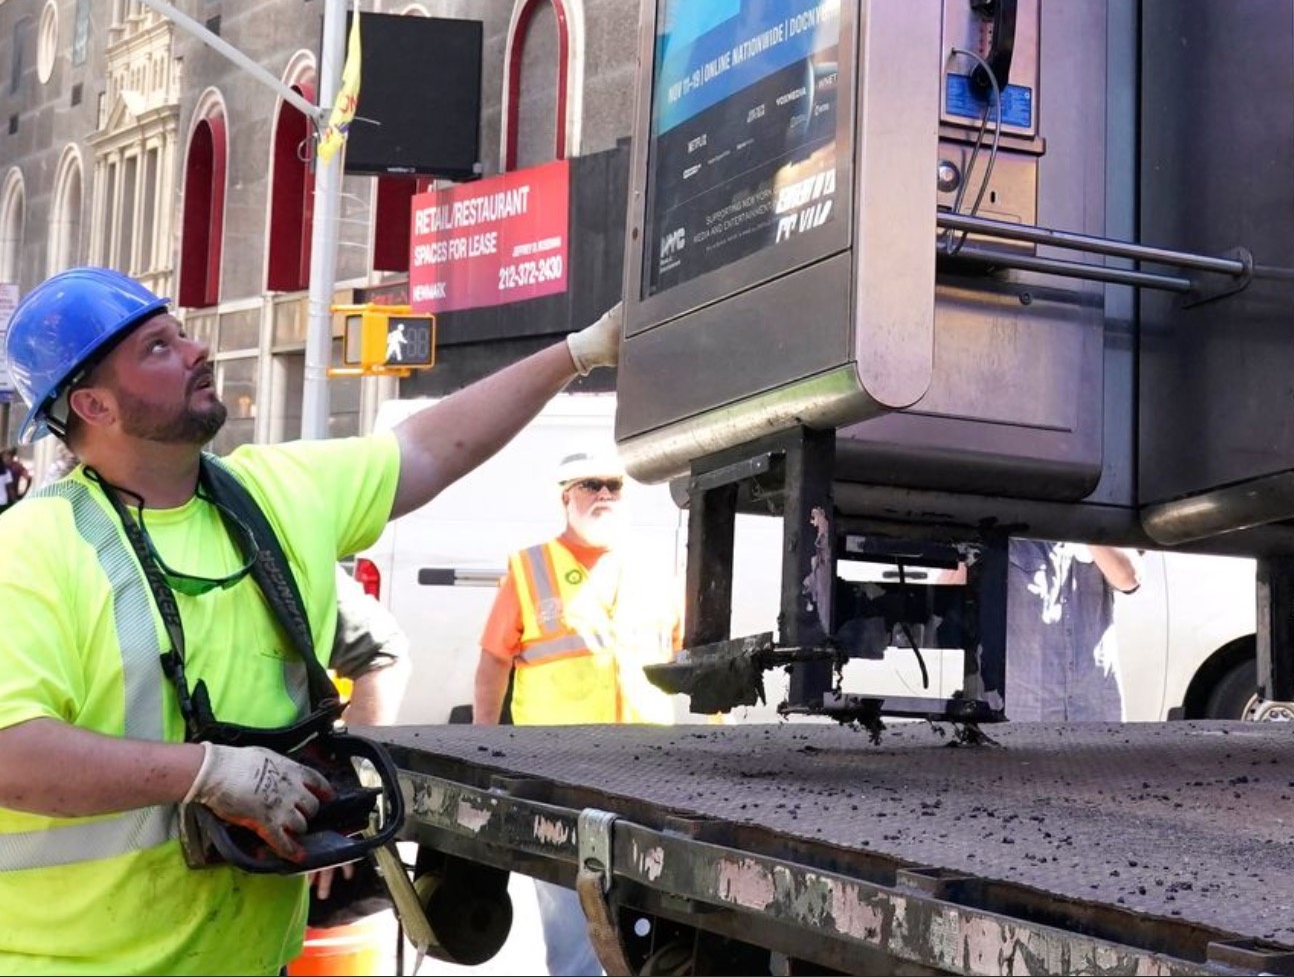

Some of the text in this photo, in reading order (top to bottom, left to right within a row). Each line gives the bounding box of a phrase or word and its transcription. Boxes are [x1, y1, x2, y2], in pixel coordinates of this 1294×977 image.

[704, 51, 730, 82] ONLINE
[732, 25, 783, 65] NATIONWIDE
[414, 232, 498, 266] SPACES FOR LEASE
